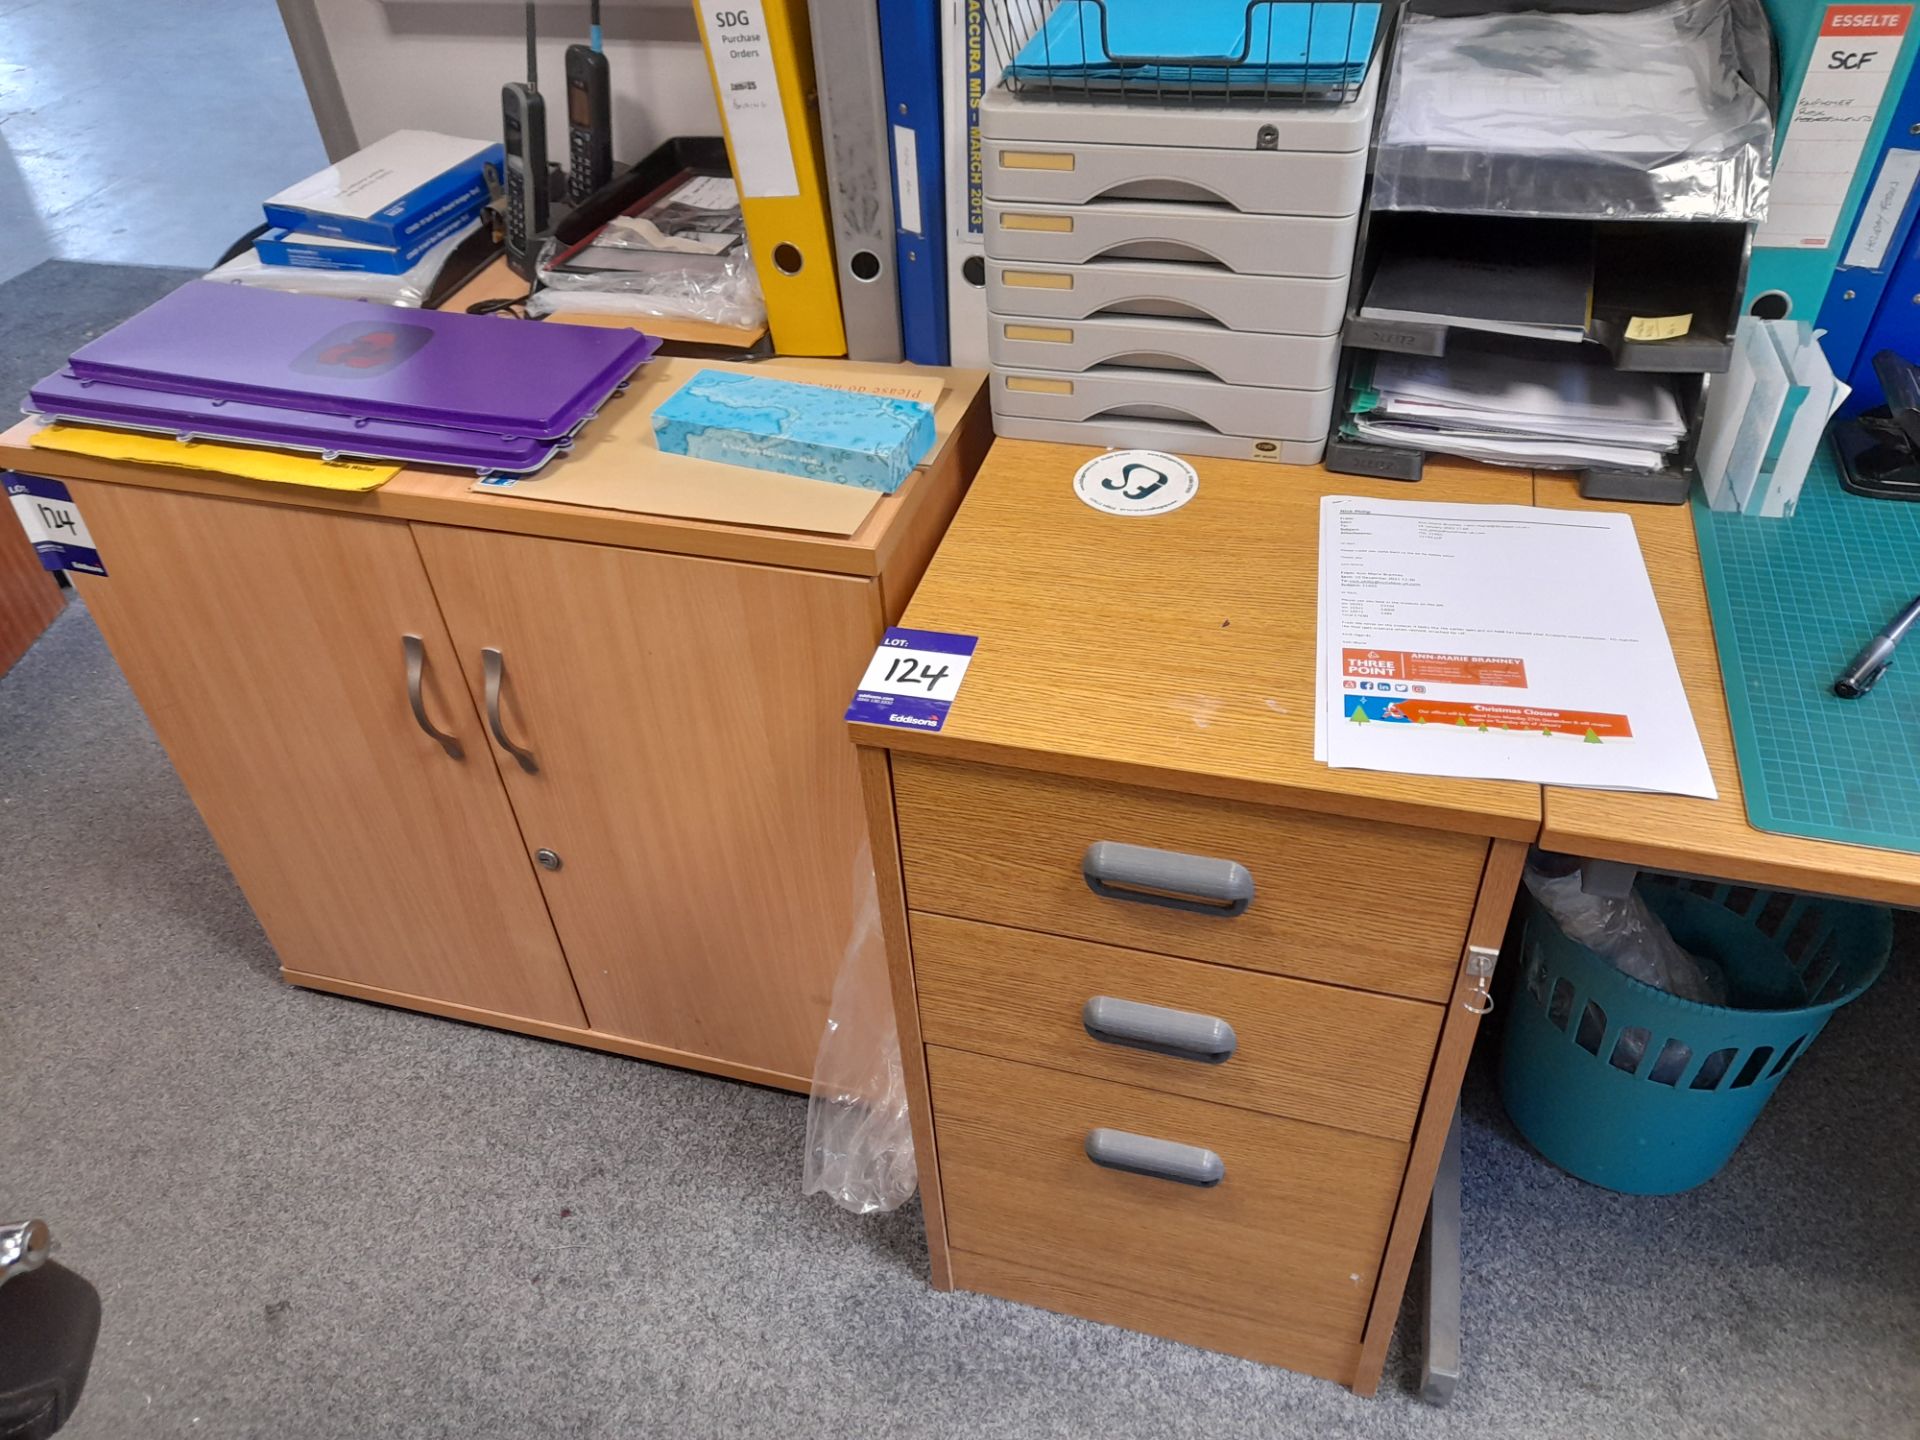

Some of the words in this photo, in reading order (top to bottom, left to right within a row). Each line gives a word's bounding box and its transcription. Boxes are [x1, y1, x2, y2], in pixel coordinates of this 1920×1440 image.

[715, 10, 750, 28] SDG
[1831, 14, 1900, 28] ESSELTE
[721, 34, 761, 44] Purchase
[968, 0, 981, 73] ACCURA
[729, 49, 760, 59] Orders
[1827, 50, 1879, 70] SCF
[969, 78, 981, 109] MIS
[970, 126, 982, 184] MARCH
[970, 188, 983, 225] 2013
[884, 637, 909, 647] LOT:
[1347, 658, 1395, 668] THREE
[1411, 652, 1469, 662] ANN-MARIE
[884, 657, 950, 692] 124
[1348, 666, 1396, 676] POINT
[1473, 704, 1522, 714] Christmas
[1523, 708, 1560, 717] Closure
[888, 713, 938, 727] Eddisons
